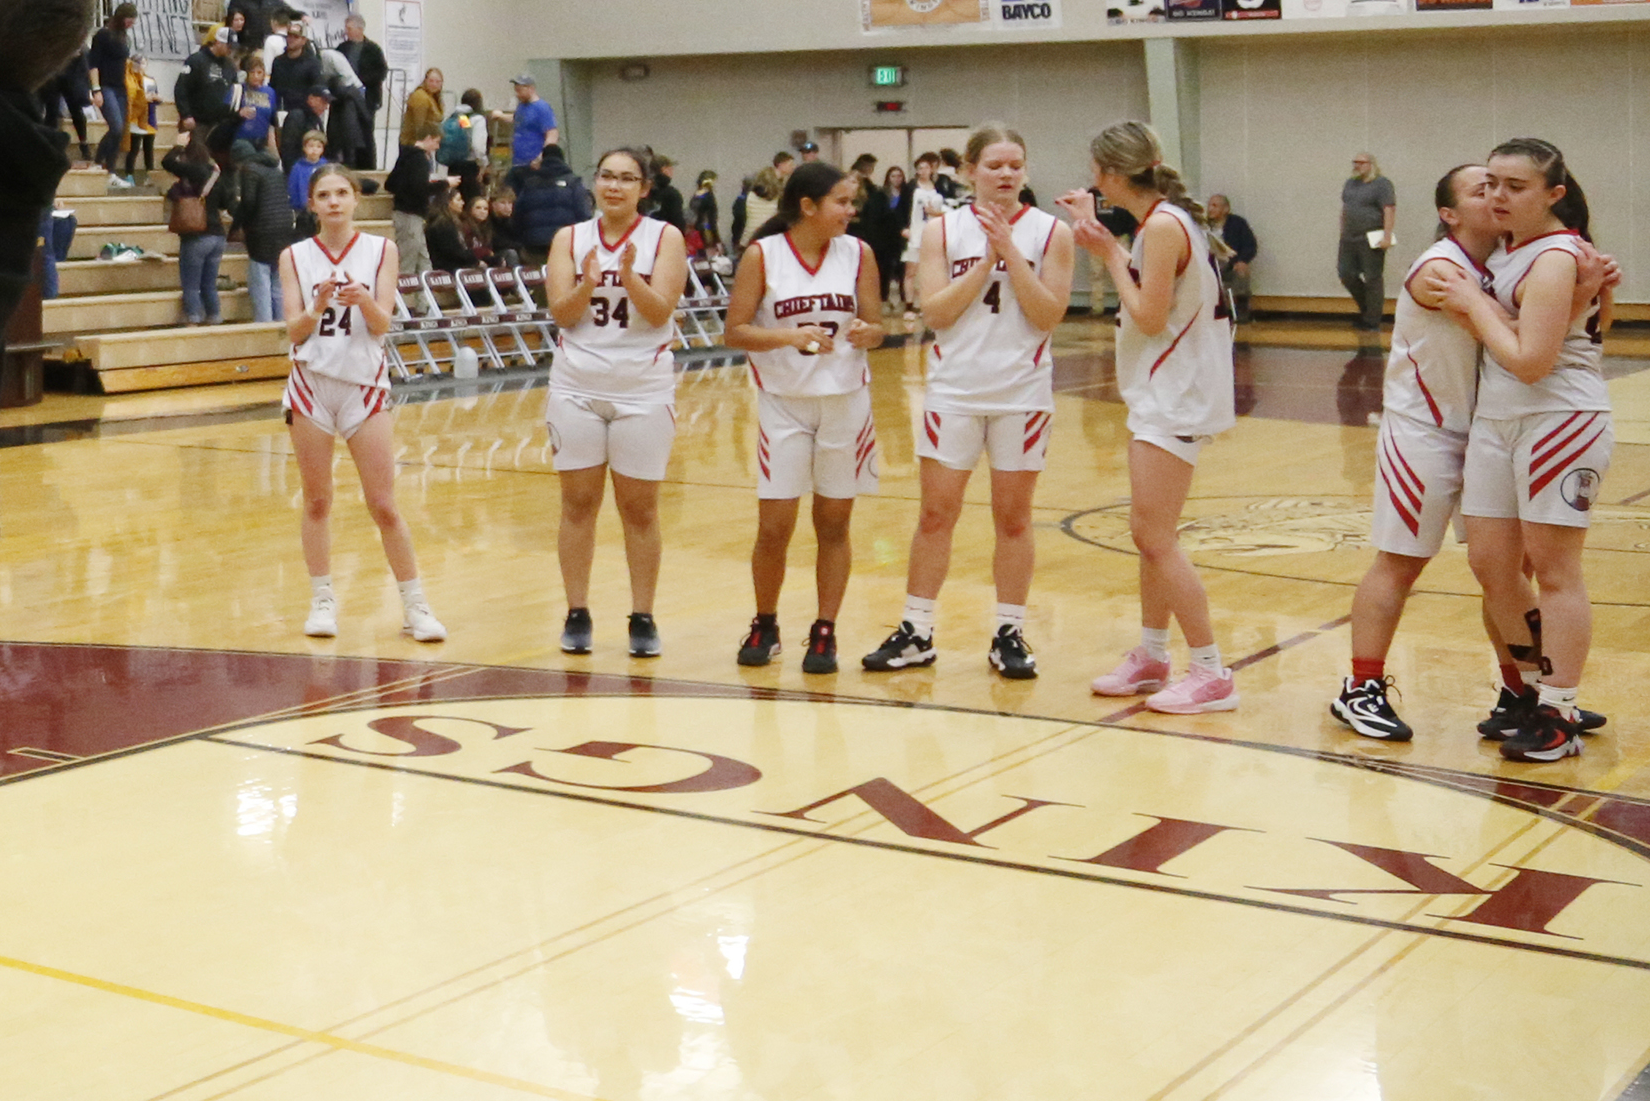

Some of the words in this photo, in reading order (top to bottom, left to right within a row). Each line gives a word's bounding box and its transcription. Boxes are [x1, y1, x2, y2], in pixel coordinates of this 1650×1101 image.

[1002, 3, 1051, 20] BAYCO
[131, 12, 155, 53] UT
[157, 14, 192, 55] NET
[590, 297, 629, 328] 34
[983, 281, 1001, 313] 4
[319, 306, 351, 336] 24
[320, 713, 1643, 939] KINGS
